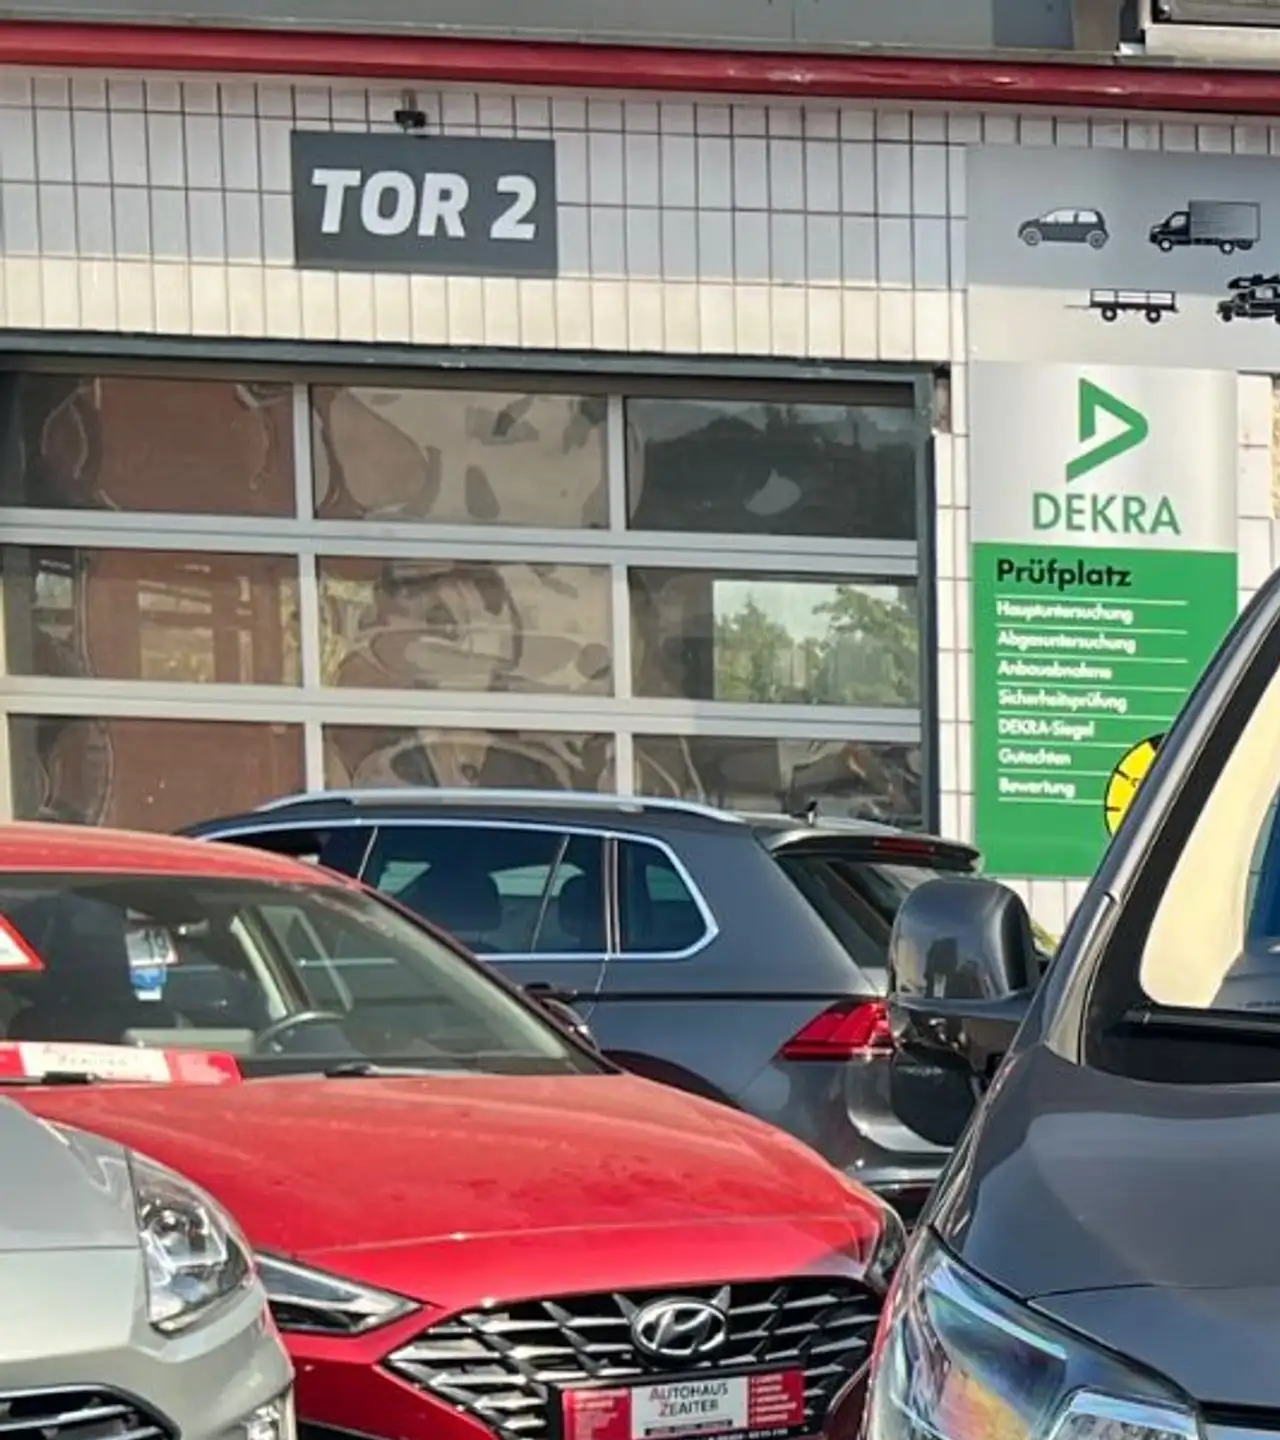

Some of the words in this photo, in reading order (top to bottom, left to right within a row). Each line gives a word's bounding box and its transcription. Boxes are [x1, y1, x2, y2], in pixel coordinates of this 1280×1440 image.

[311, 168, 469, 238] TOR
[489, 175, 536, 240] 2
[1033, 492, 1181, 536] DEKRA
[997, 558, 1132, 591] Prüfplatz
[996, 600, 1134, 625] Hauptuntersuchung
[998, 630, 1137, 654] Abgasuntersuchung
[998, 689, 1128, 714] Sicherheitsprüfung
[998, 719, 1096, 740] DEKRA-Siegel
[998, 748, 1072, 767] Gutachten
[998, 778, 1076, 799] Bewertung
[650, 1383, 729, 1401] AUTOHAUS
